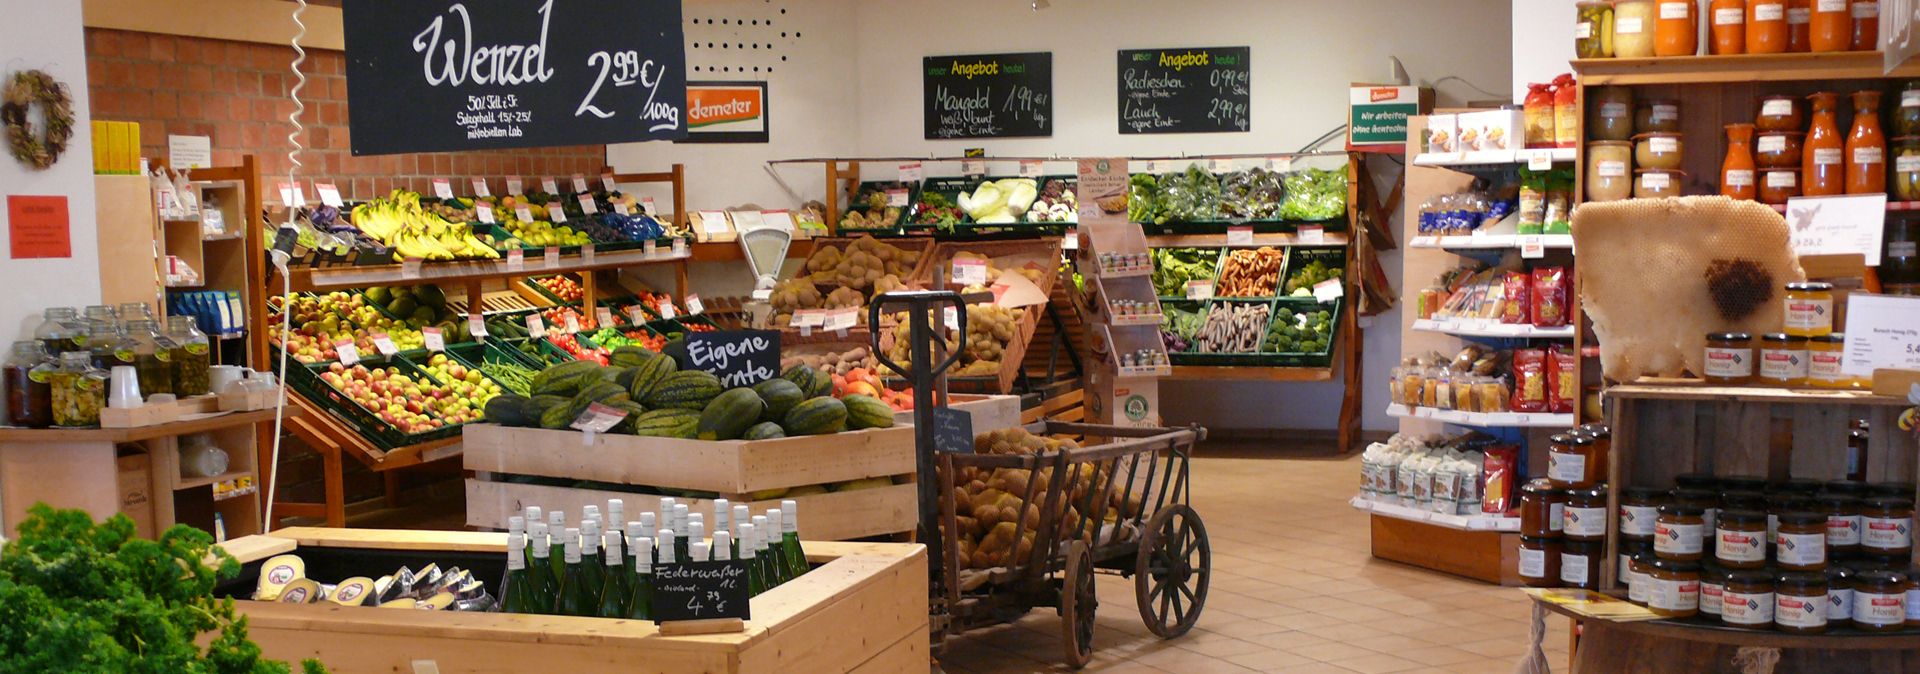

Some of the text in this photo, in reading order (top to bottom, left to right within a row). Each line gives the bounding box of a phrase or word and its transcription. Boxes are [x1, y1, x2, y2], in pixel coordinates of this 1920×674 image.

[412, 0, 554, 88] Wenzel
[951, 60, 999, 80] Angebot
[1159, 51, 1209, 71] Angebot
[689, 97, 751, 120] demeter
[1123, 98, 1161, 120] Lauch
[1375, 111, 1407, 120] arbeiten
[508, 124, 523, 137] Lab
[1353, 125, 1370, 133] ohne
[686, 336, 769, 370] Eigene
[704, 359, 774, 389] rnte
[686, 596, 703, 616] 4
[716, 600, 728, 612] €
